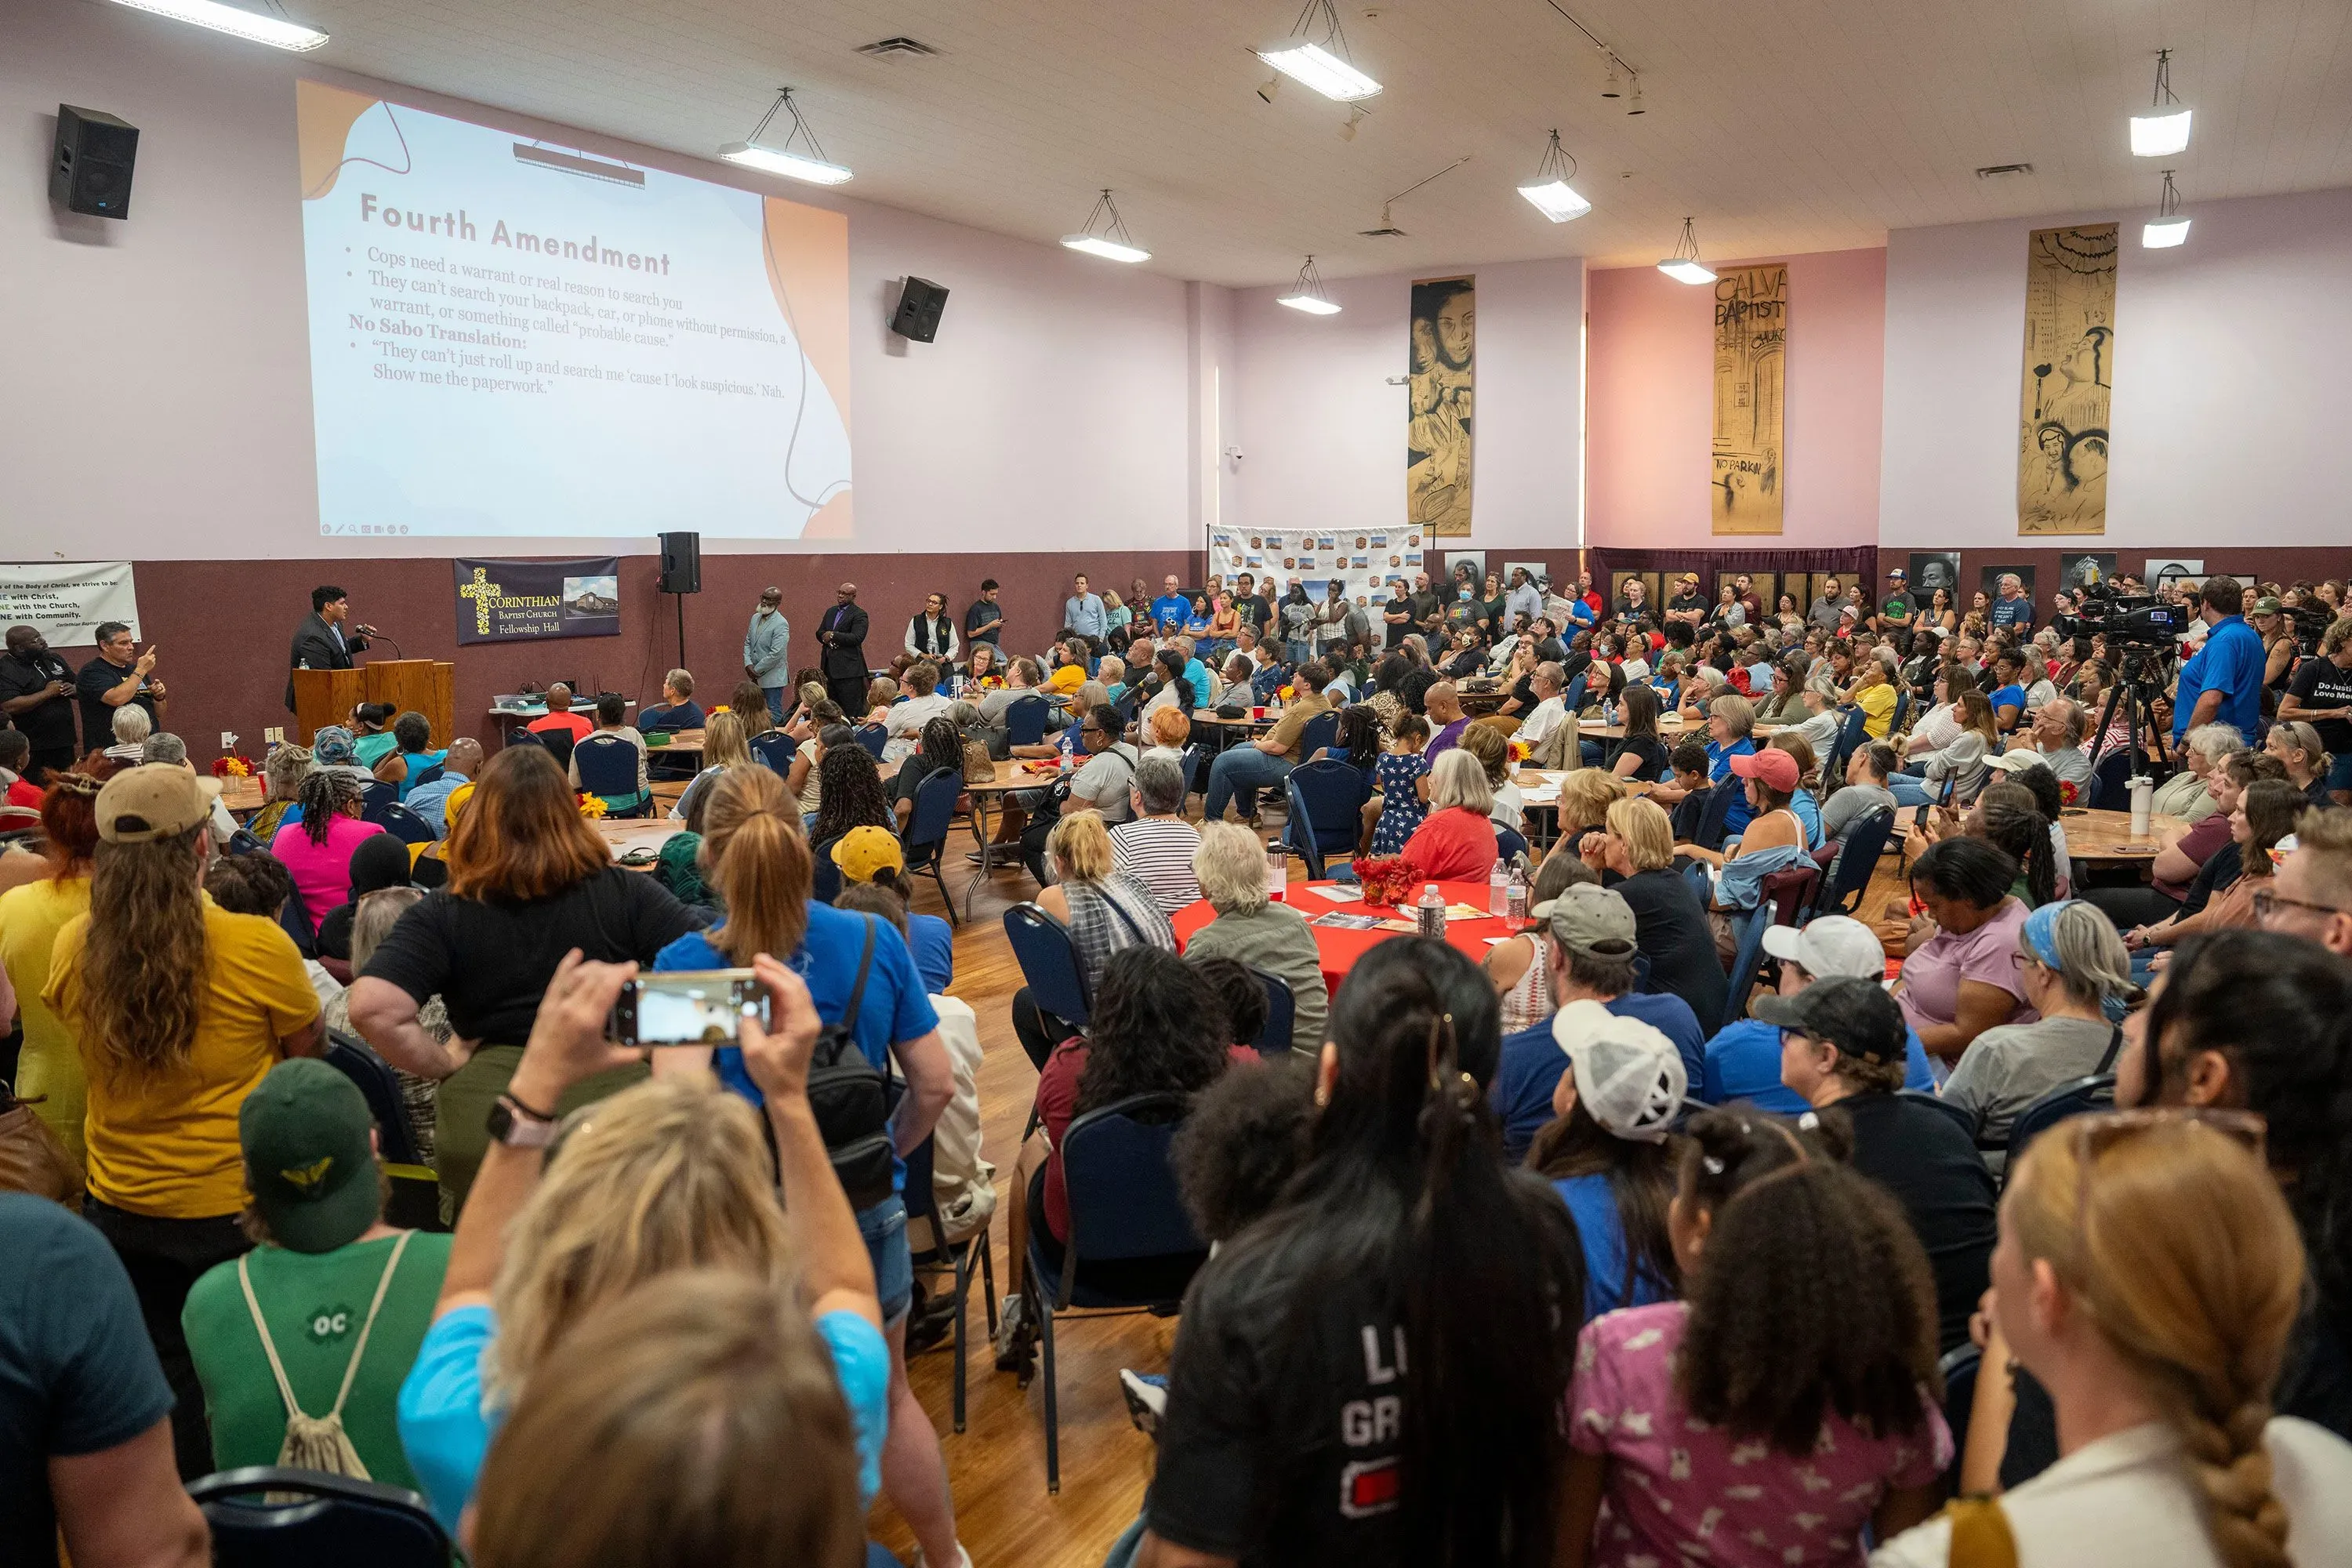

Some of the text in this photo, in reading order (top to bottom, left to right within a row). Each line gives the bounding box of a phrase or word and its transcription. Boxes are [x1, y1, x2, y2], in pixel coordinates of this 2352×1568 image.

[361, 192, 670, 276] Fourth Amendment
[368, 245, 683, 311] Cops need a warrant or real reason to search you
[368, 269, 786, 345] They can’t search your backpack, car, or phone without permission, a
[370, 296, 674, 347] warrant, or something called “probable cause.”
[1715, 299, 1786, 328] BAPTIST
[348, 313, 527, 350] No Sabo Translation:
[372, 339, 417, 363] “They
[421, 347, 456, 365] can’t
[458, 350, 485, 368] just
[489, 354, 512, 370] roll
[517, 360, 532, 375] up
[536, 360, 560, 375] and
[564, 365, 603, 379] search
[606, 370, 625, 382] me
[664, 372, 670, 386] I
[761, 384, 785, 398] Nah.
[372, 363, 554, 394] Show me the paperwork.”
[1716, 459, 1728, 470] NO
[488, 596, 561, 608] CORINTHIAN
[499, 622, 561, 634] Fellowship Hall
[2318, 681, 2352, 692] Do Justi
